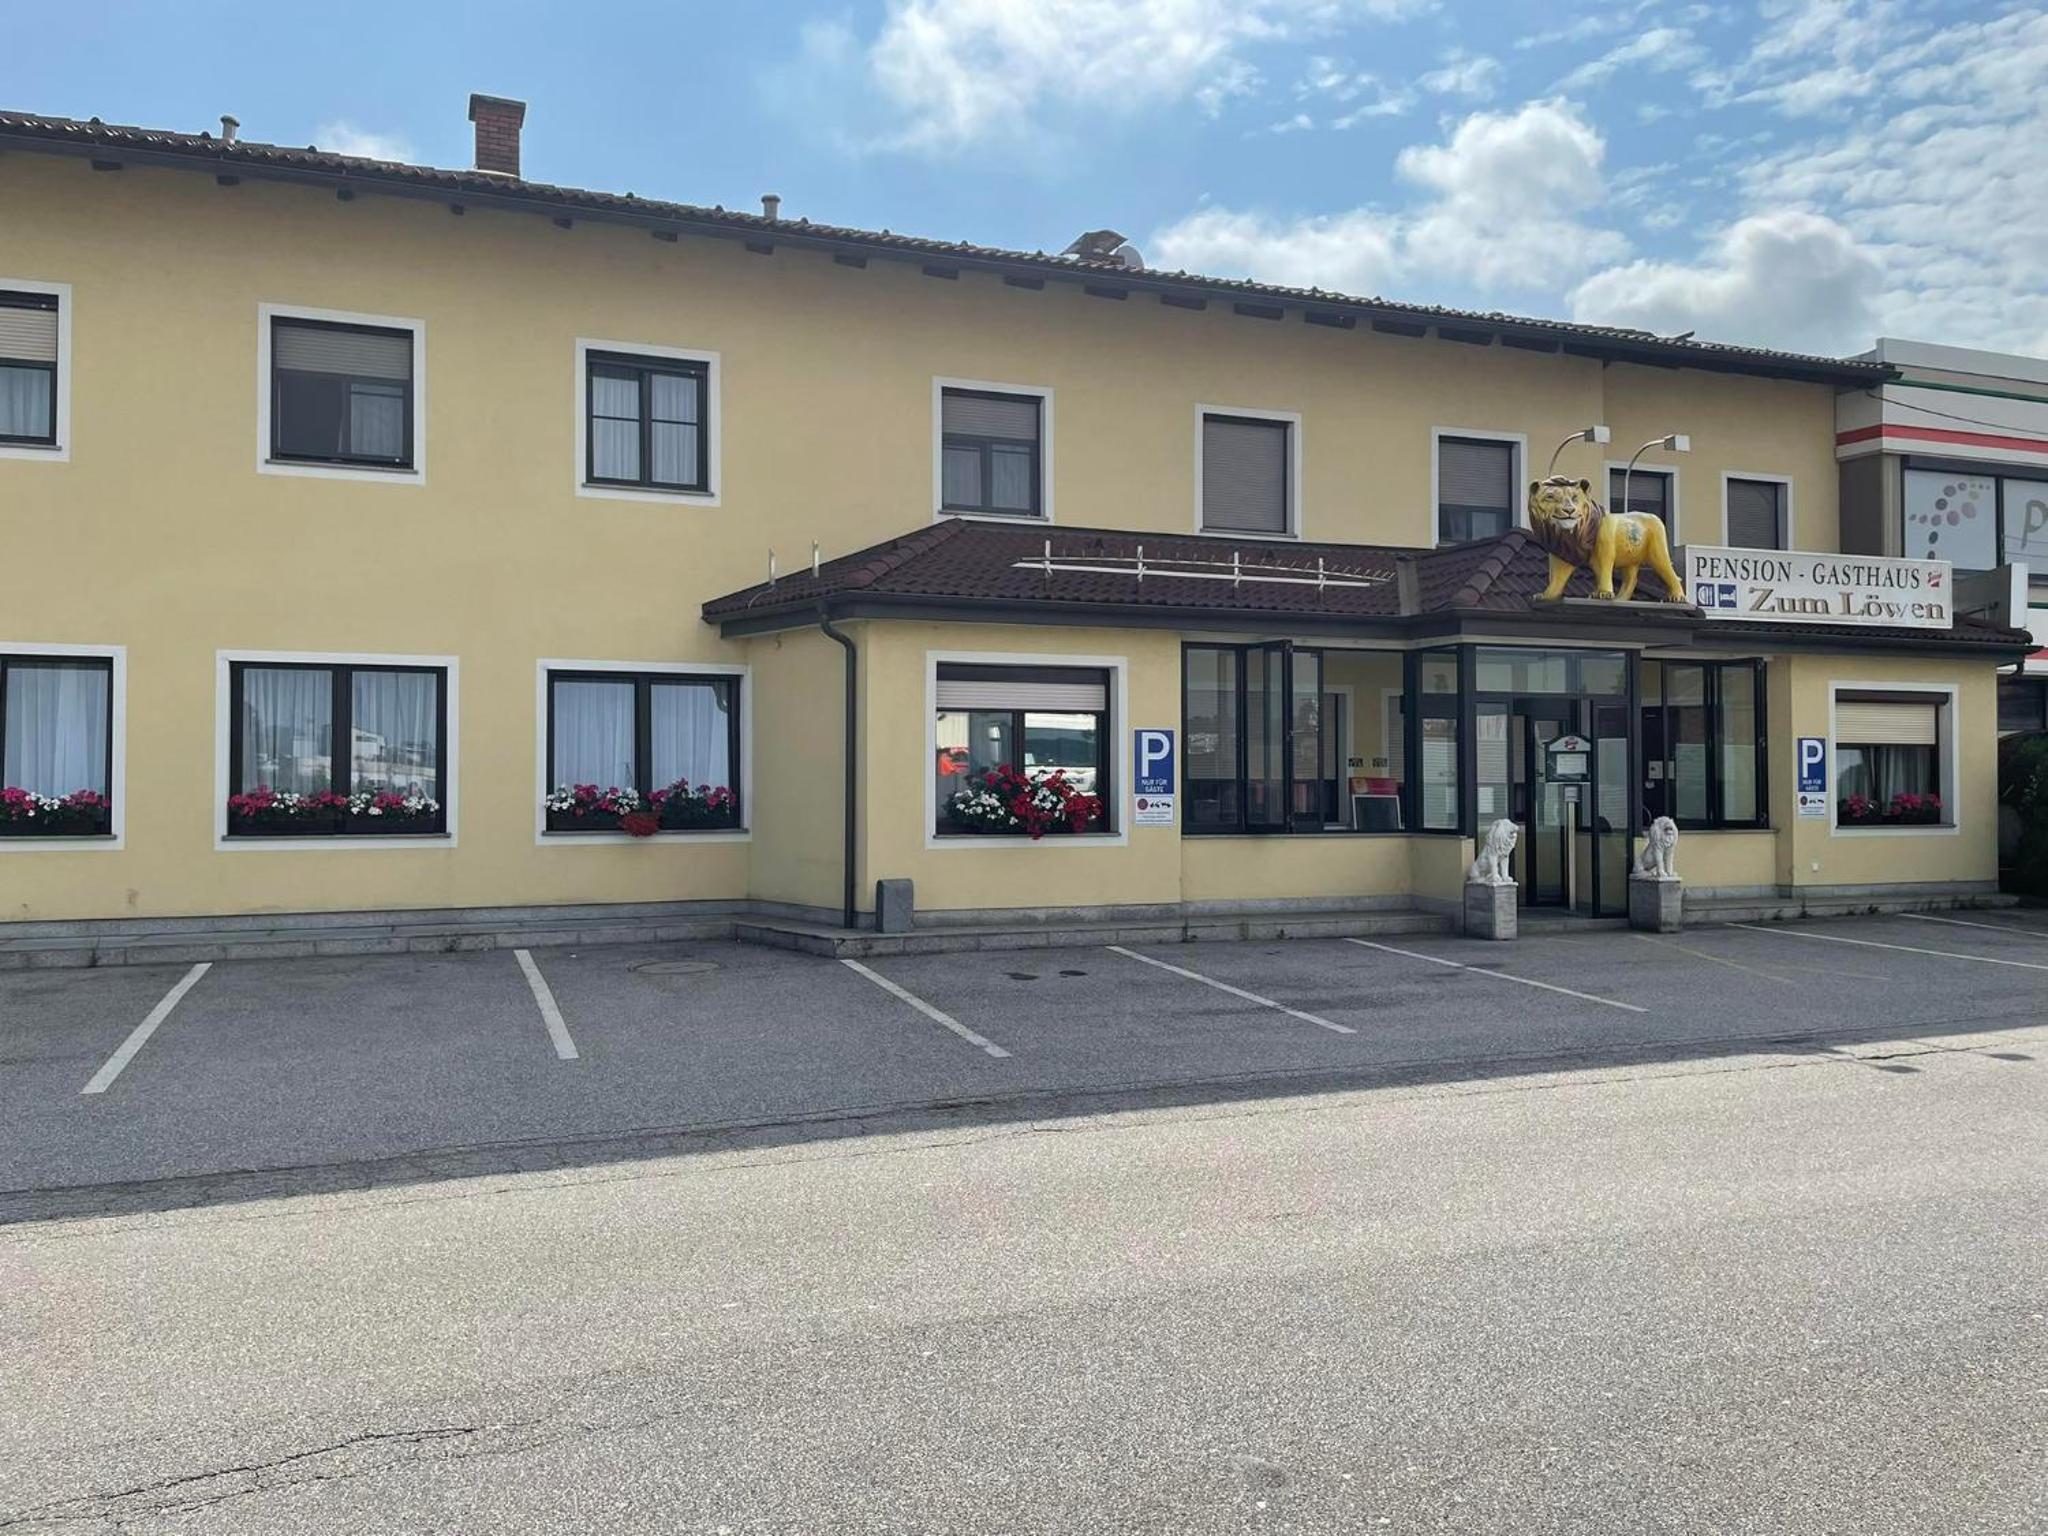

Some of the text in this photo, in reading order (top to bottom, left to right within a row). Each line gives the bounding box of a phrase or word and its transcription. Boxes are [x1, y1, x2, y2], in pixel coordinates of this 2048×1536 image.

[1695, 556, 1792, 582] PENSION
[1812, 563, 1920, 589] GASTHAUS
[1748, 587, 1945, 620] Zum Löwen
[1141, 731, 1170, 777] P
[1802, 740, 1823, 778] P
